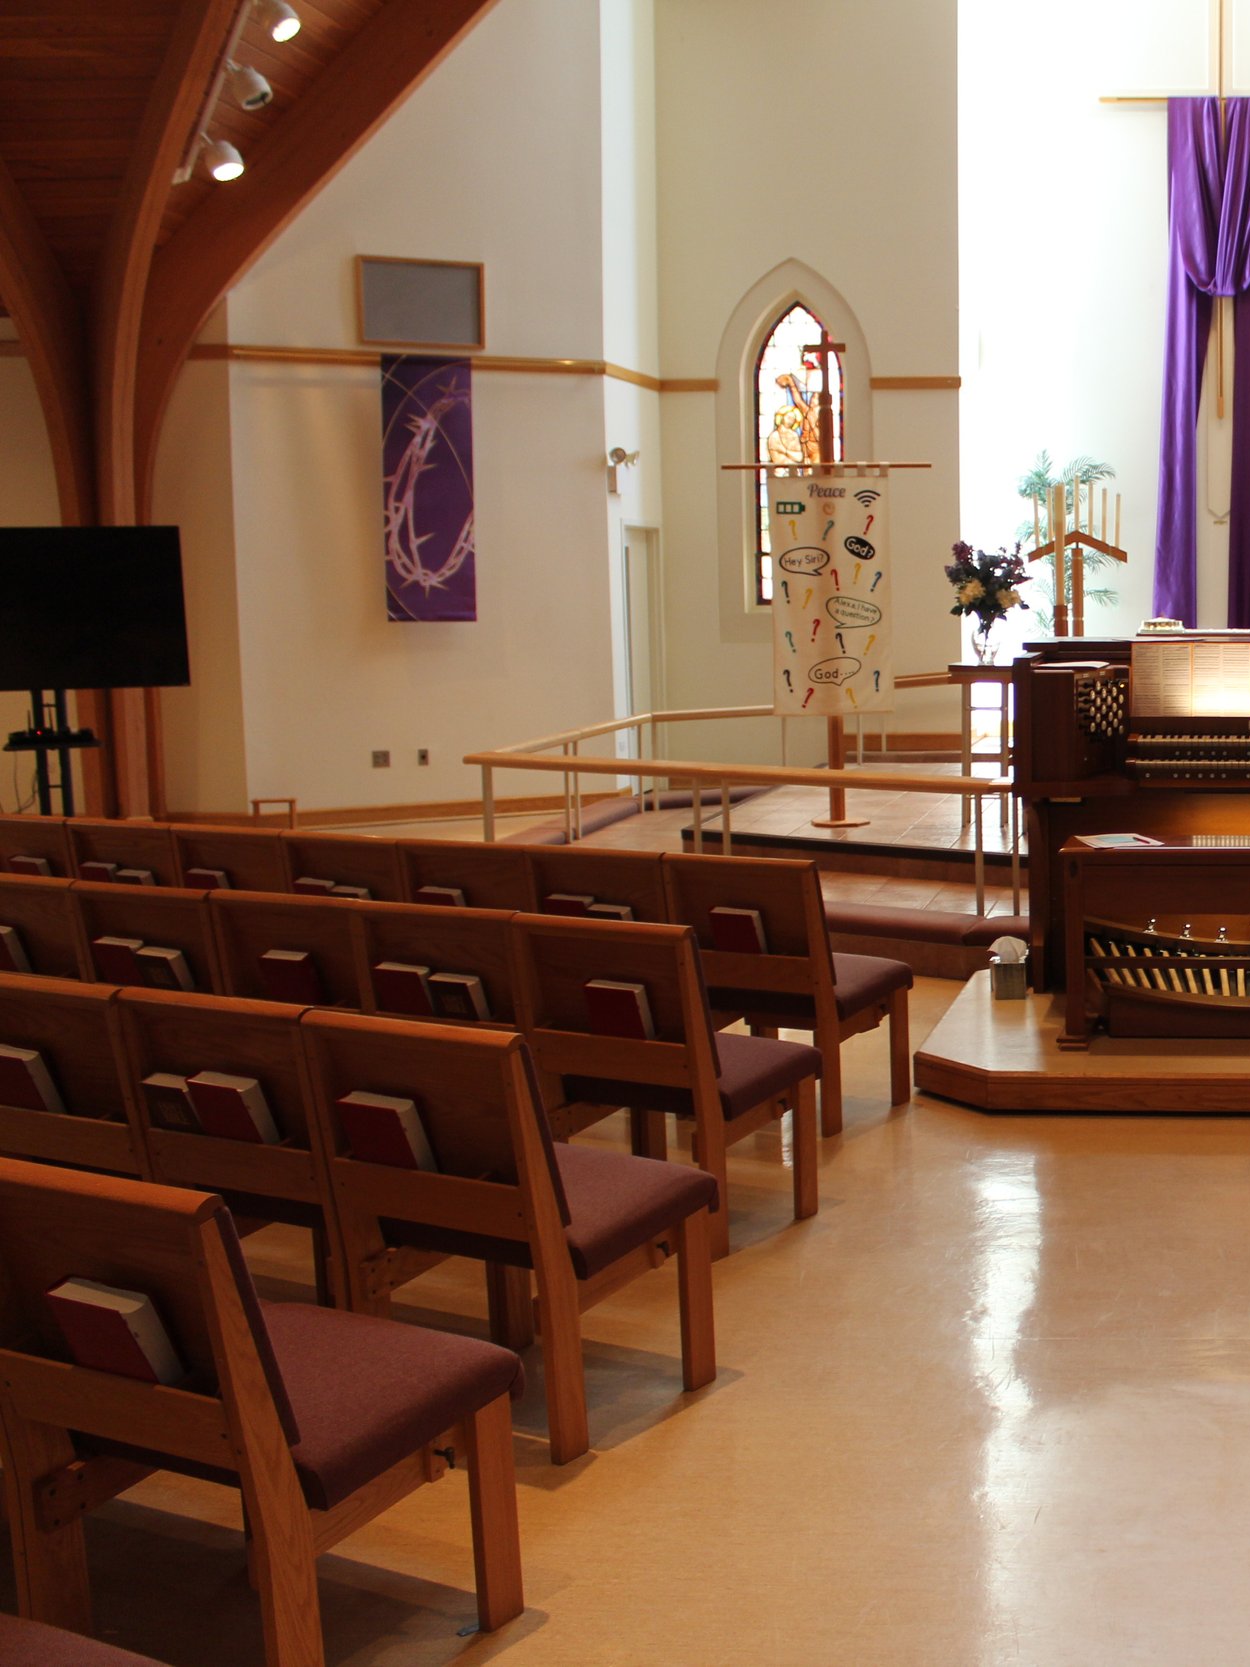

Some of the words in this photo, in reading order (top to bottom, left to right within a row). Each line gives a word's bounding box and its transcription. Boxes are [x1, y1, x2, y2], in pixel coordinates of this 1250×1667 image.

[807, 483, 846, 498] Peace
[846, 538, 874, 559] God?
[784, 556, 802, 568] Hey
[804, 553, 825, 565] Siri?
